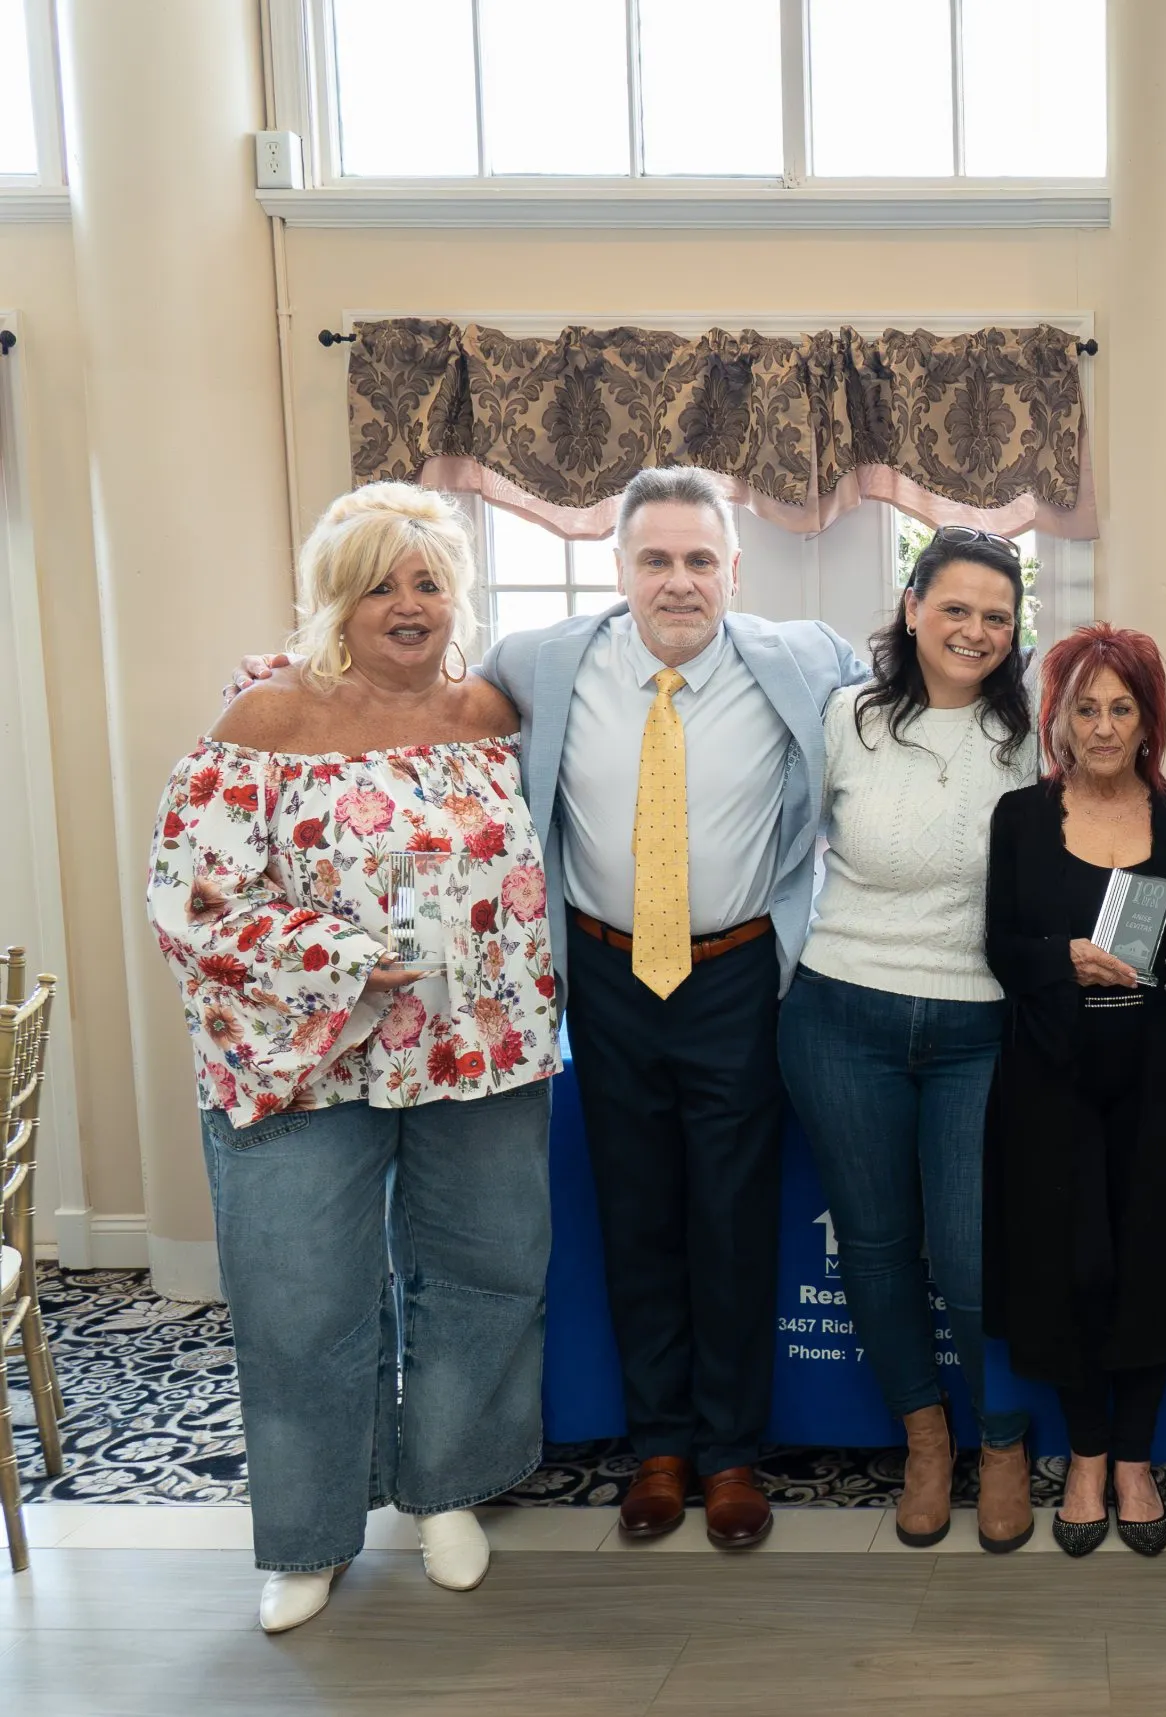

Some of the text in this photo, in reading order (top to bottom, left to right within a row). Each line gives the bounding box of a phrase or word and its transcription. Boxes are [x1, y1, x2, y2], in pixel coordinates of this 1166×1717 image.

[1132, 880, 1165, 905] 100
[800, 1285, 847, 1305] Rea
[778, 1317, 816, 1332] 3457
[788, 1345, 846, 1360] Phone:
